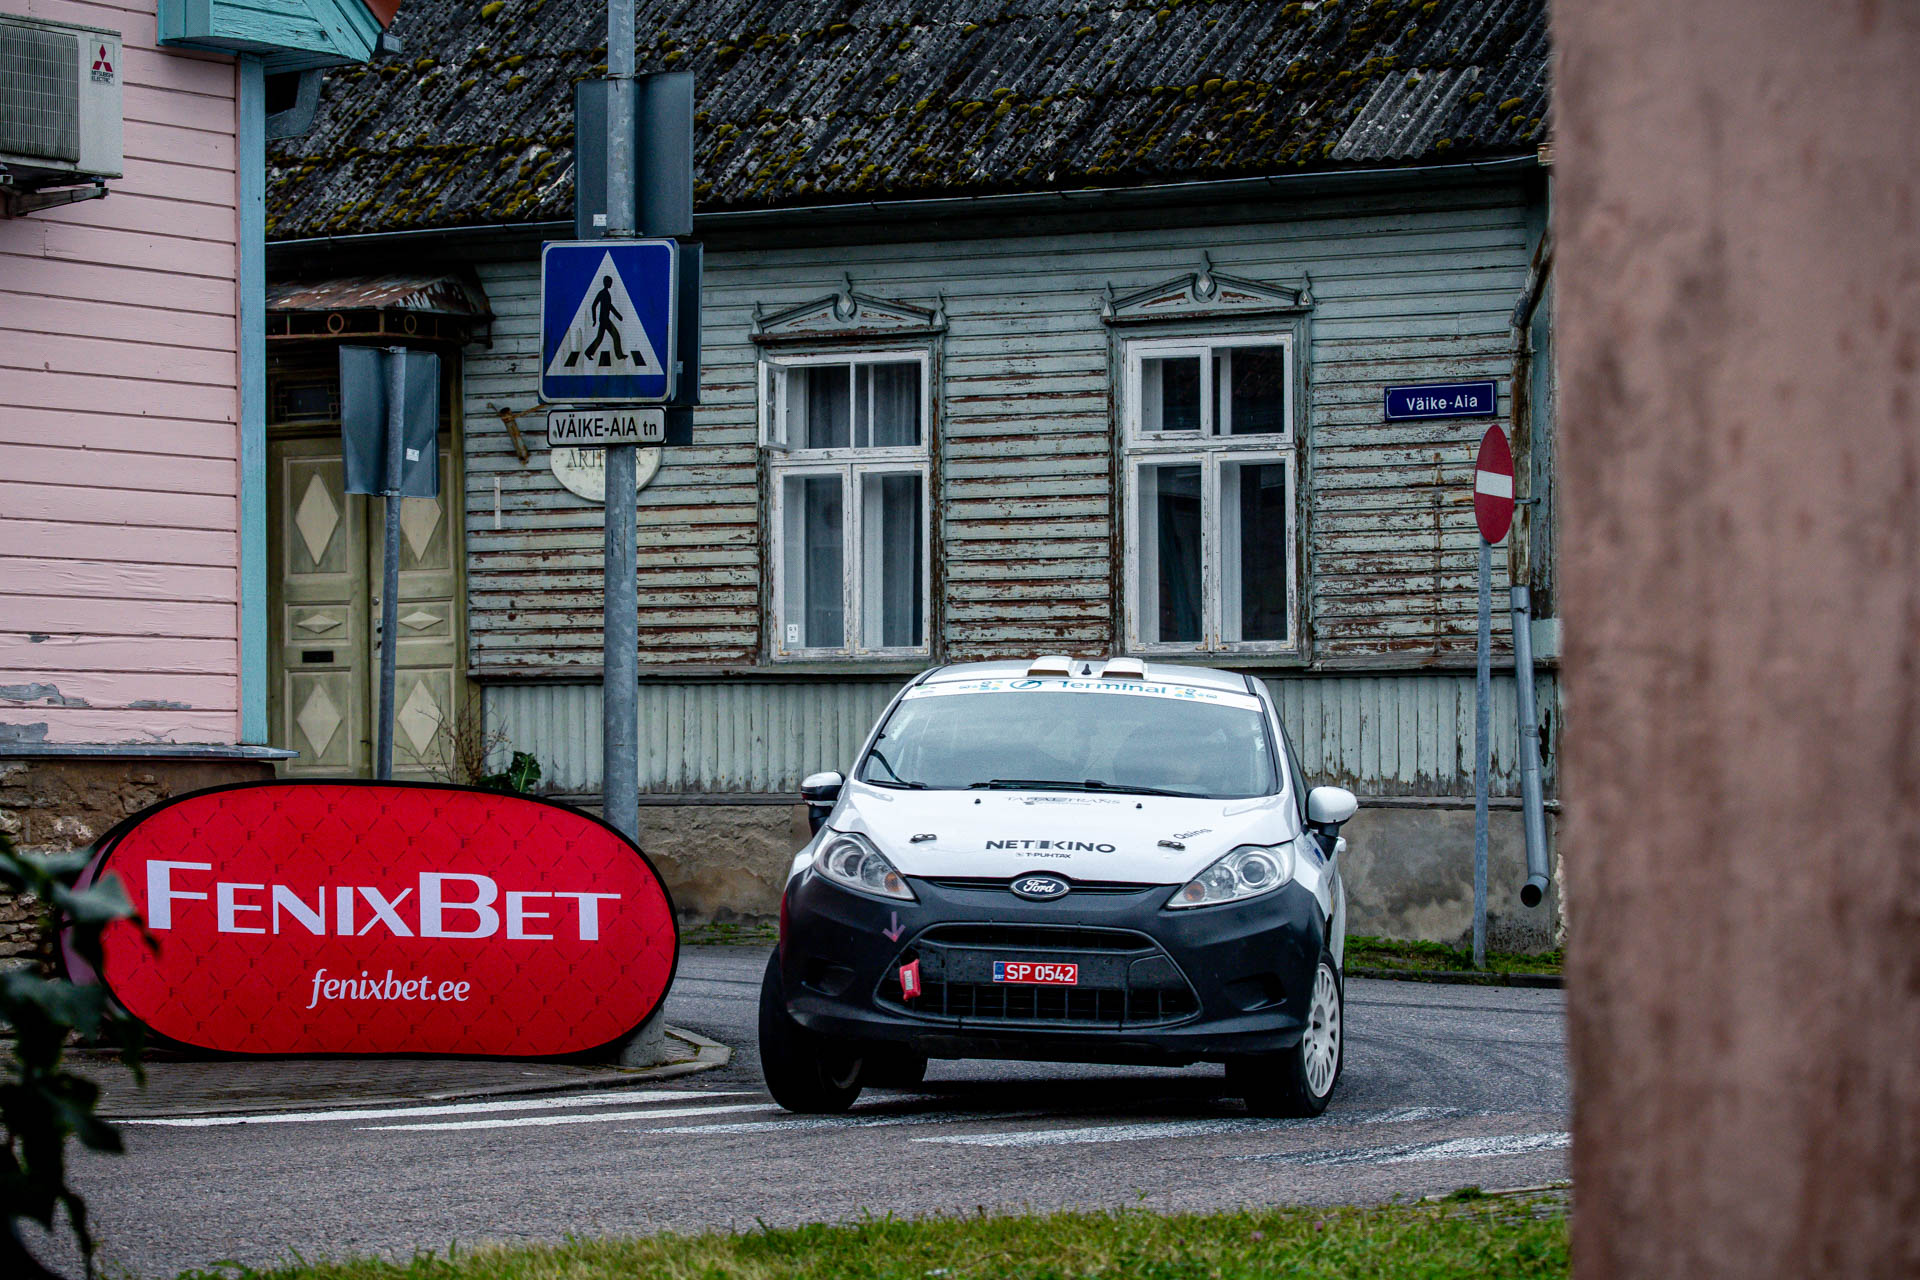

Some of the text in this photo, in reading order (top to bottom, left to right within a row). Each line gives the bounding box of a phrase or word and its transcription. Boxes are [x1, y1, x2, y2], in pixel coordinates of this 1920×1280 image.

[1406, 395, 1478, 411] Väike-Aia
[555, 414, 657, 438] VÄIKE-AIA tn
[1057, 680, 1166, 695] Terminal
[1023, 877, 1055, 894] Ford
[146, 859, 622, 942] FENIXBET
[1006, 964, 1075, 982] SP 0542
[306, 968, 471, 1010] fenixbet.ee
